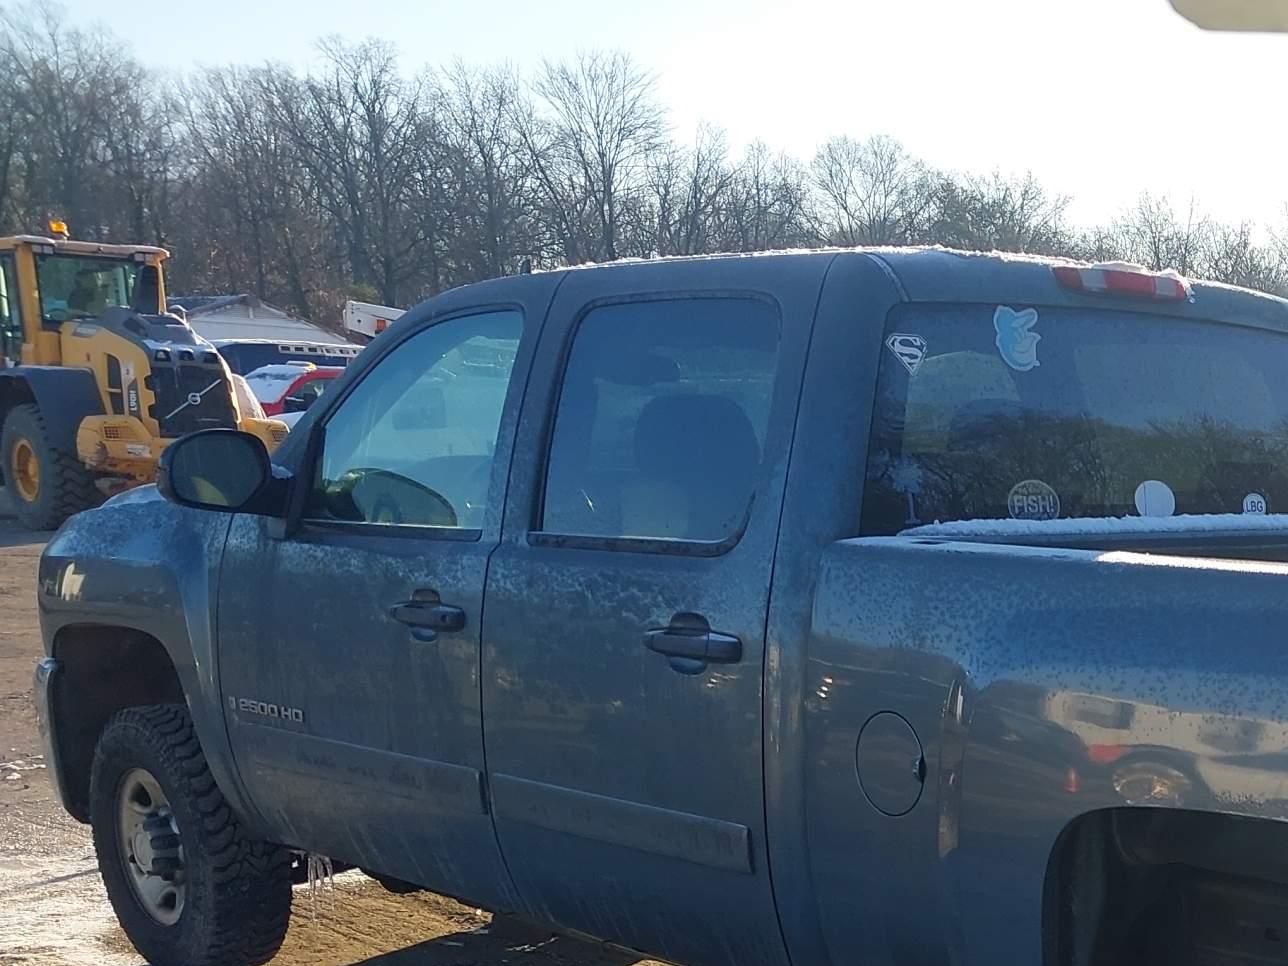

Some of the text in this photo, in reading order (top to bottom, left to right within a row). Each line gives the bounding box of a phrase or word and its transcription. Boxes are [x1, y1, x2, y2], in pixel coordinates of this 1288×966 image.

[1013, 494, 1054, 514] FISH!
[1246, 500, 1264, 513] LBG
[239, 698, 304, 722] 2500 HD
